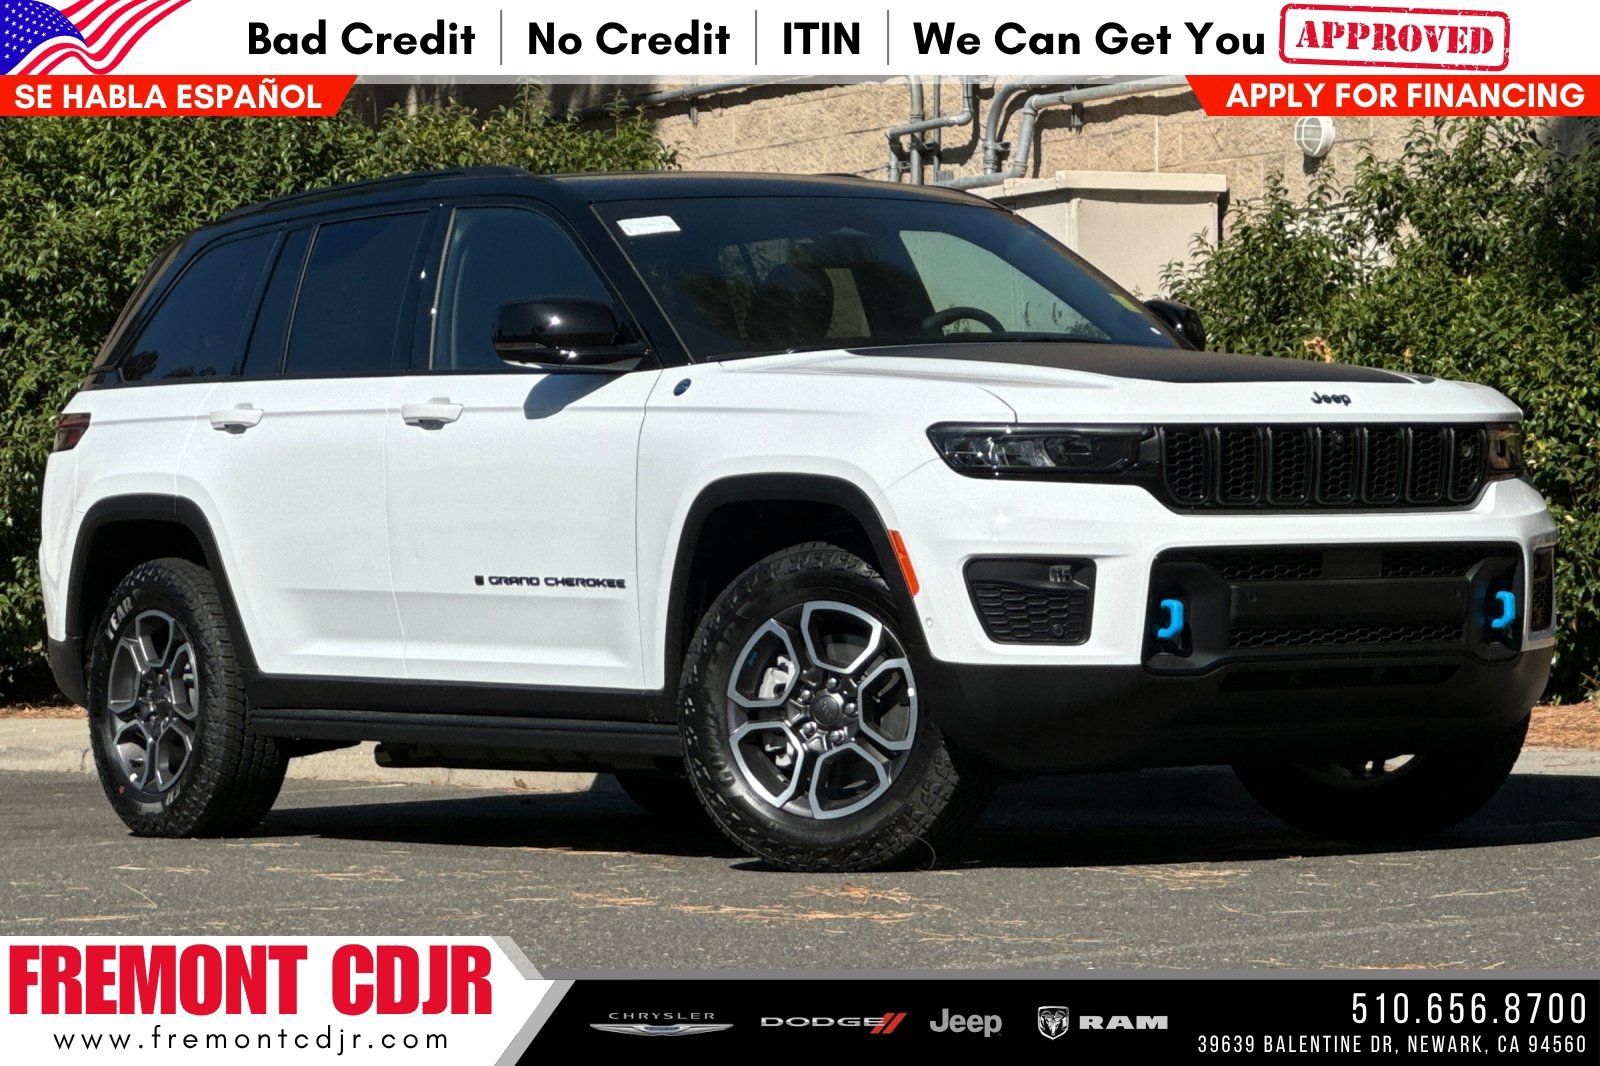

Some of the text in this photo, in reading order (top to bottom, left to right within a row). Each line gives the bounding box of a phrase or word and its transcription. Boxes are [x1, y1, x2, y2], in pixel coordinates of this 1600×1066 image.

[1310, 391, 1352, 407] Jeep
[488, 575, 627, 589] GRAND CHEROKEE
